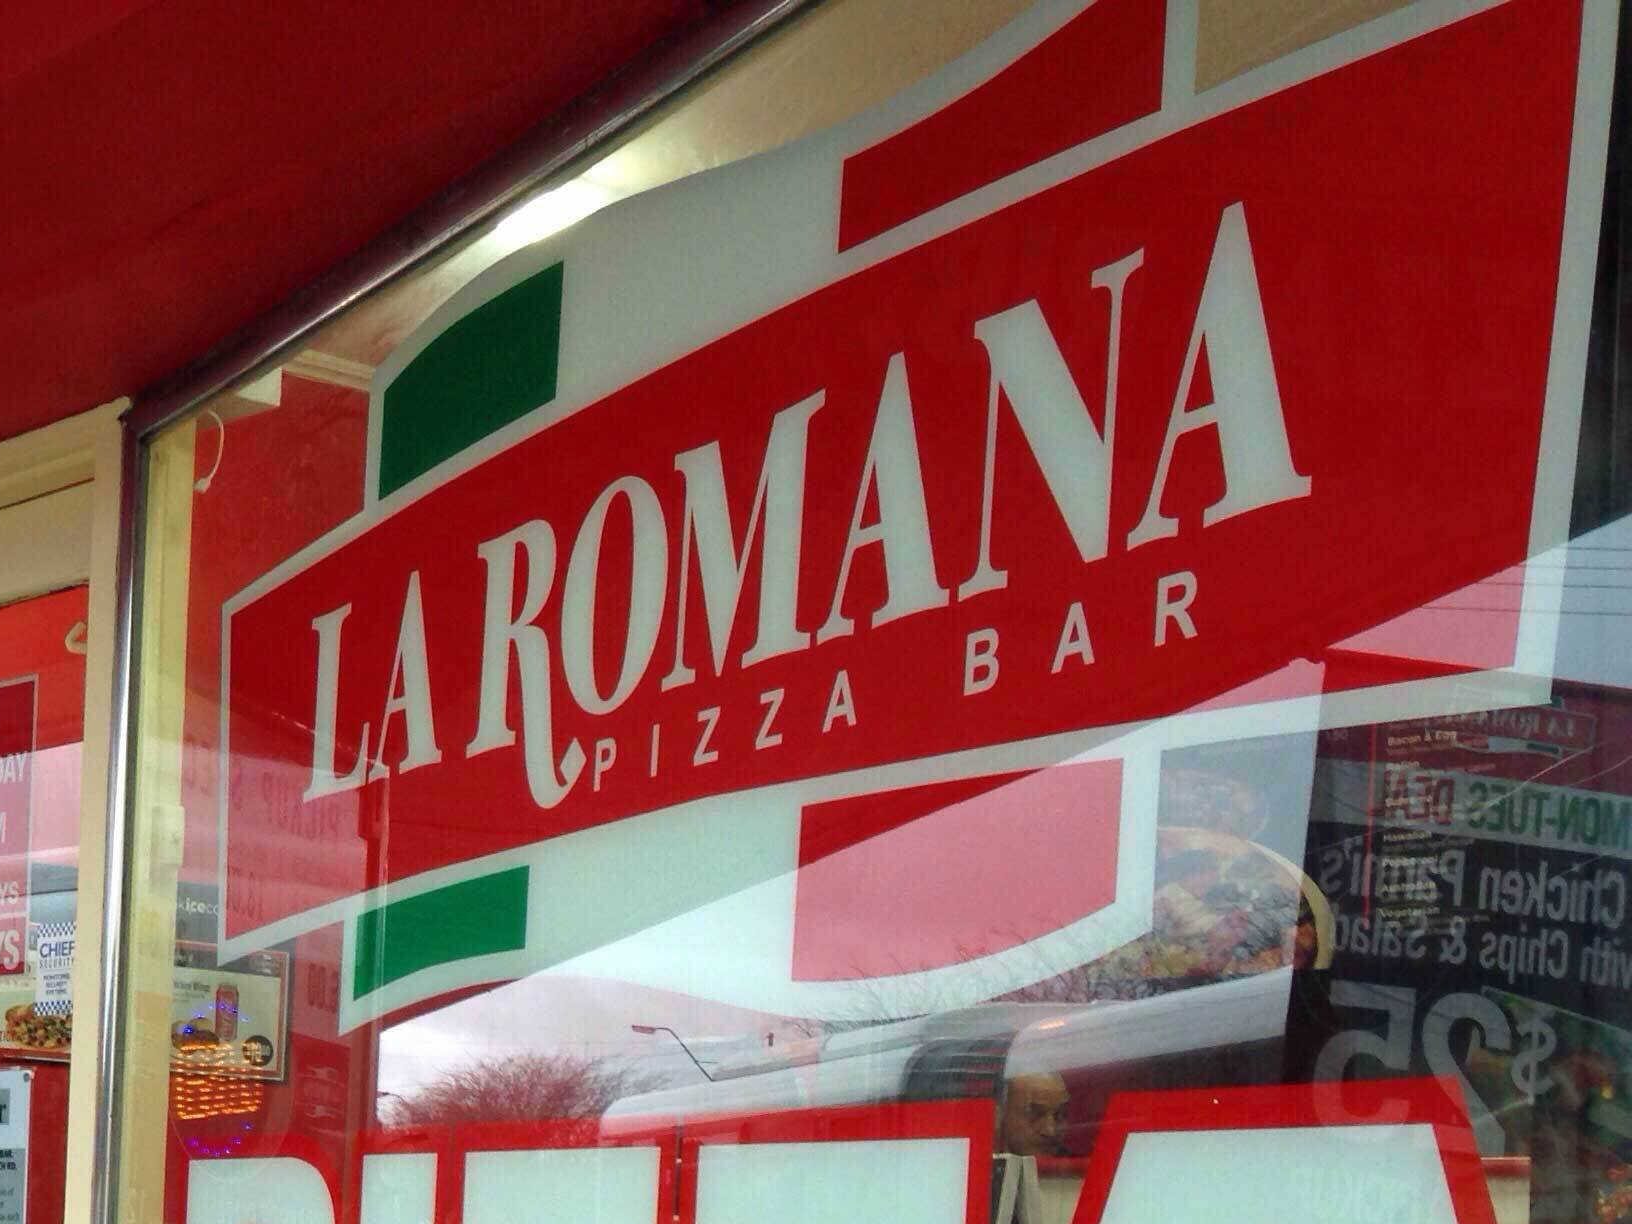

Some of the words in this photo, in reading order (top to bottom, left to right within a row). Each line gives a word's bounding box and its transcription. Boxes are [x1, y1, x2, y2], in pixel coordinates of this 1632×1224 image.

[303, 571, 442, 803] LA
[467, 202, 1311, 811] ROMANA
[595, 671, 856, 791] PIZZA
[964, 572, 1196, 695] BAR
[40, 941, 75, 958] CHIEF
